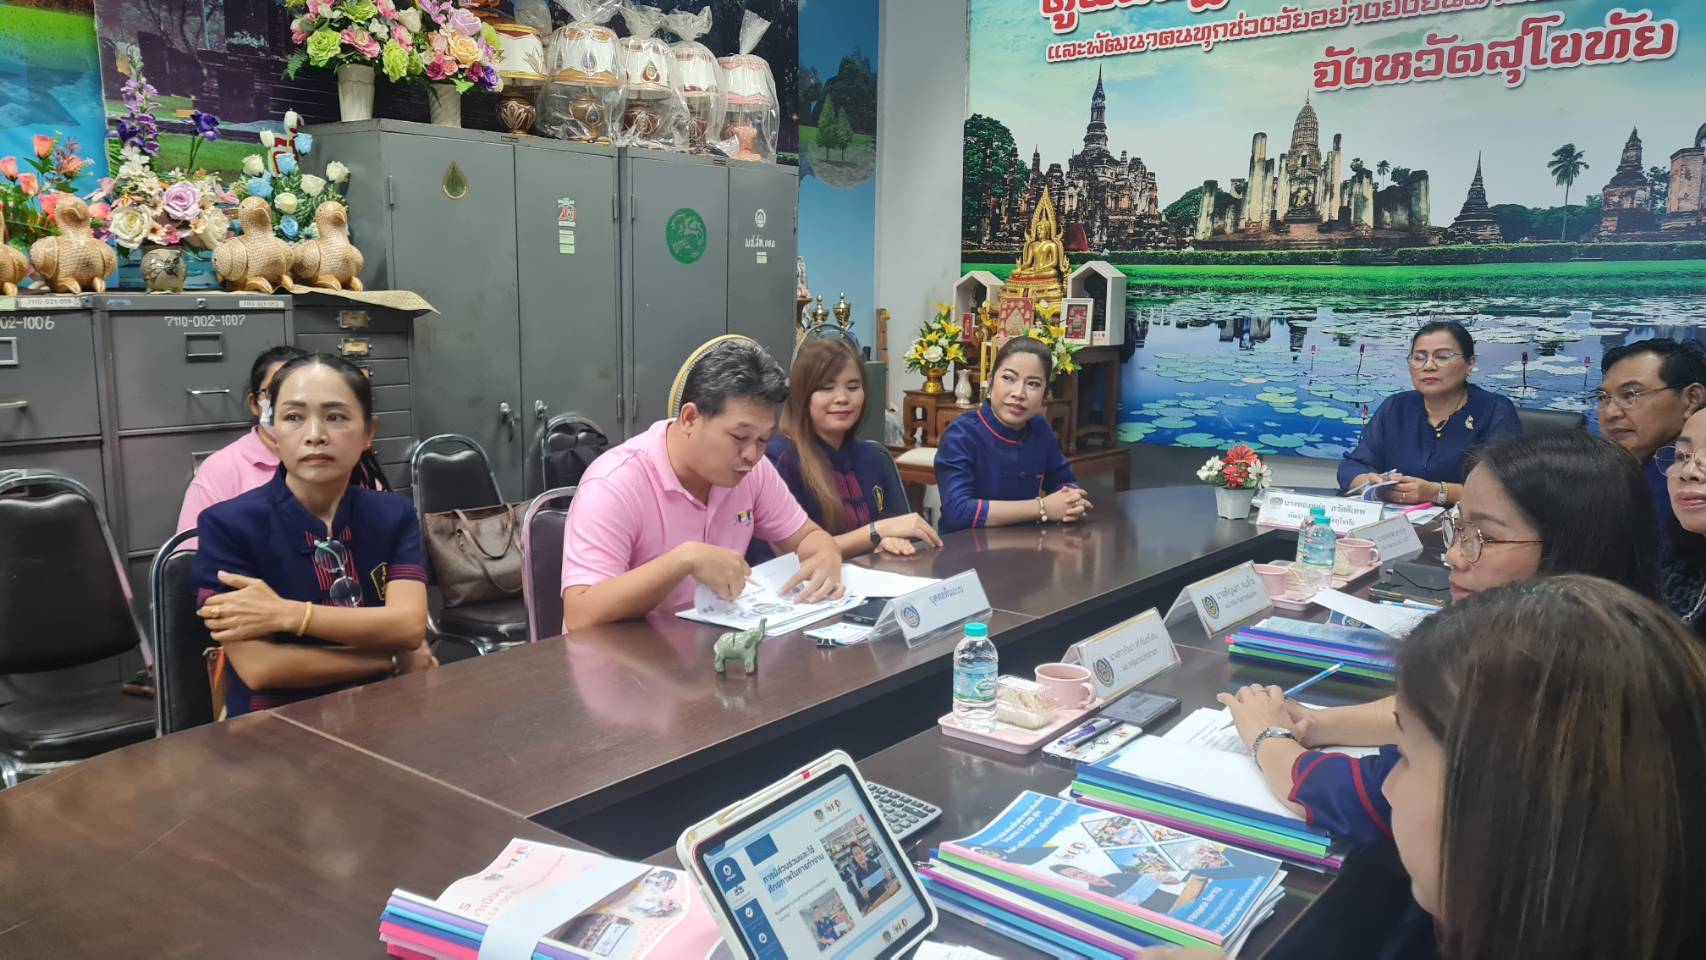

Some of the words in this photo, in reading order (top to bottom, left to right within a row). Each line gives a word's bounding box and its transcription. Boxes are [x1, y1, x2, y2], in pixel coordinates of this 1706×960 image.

[1313, 12, 1675, 88] จังหวัดสุโขทัย
[163, 314, 247, 328] 7110-002-1007
